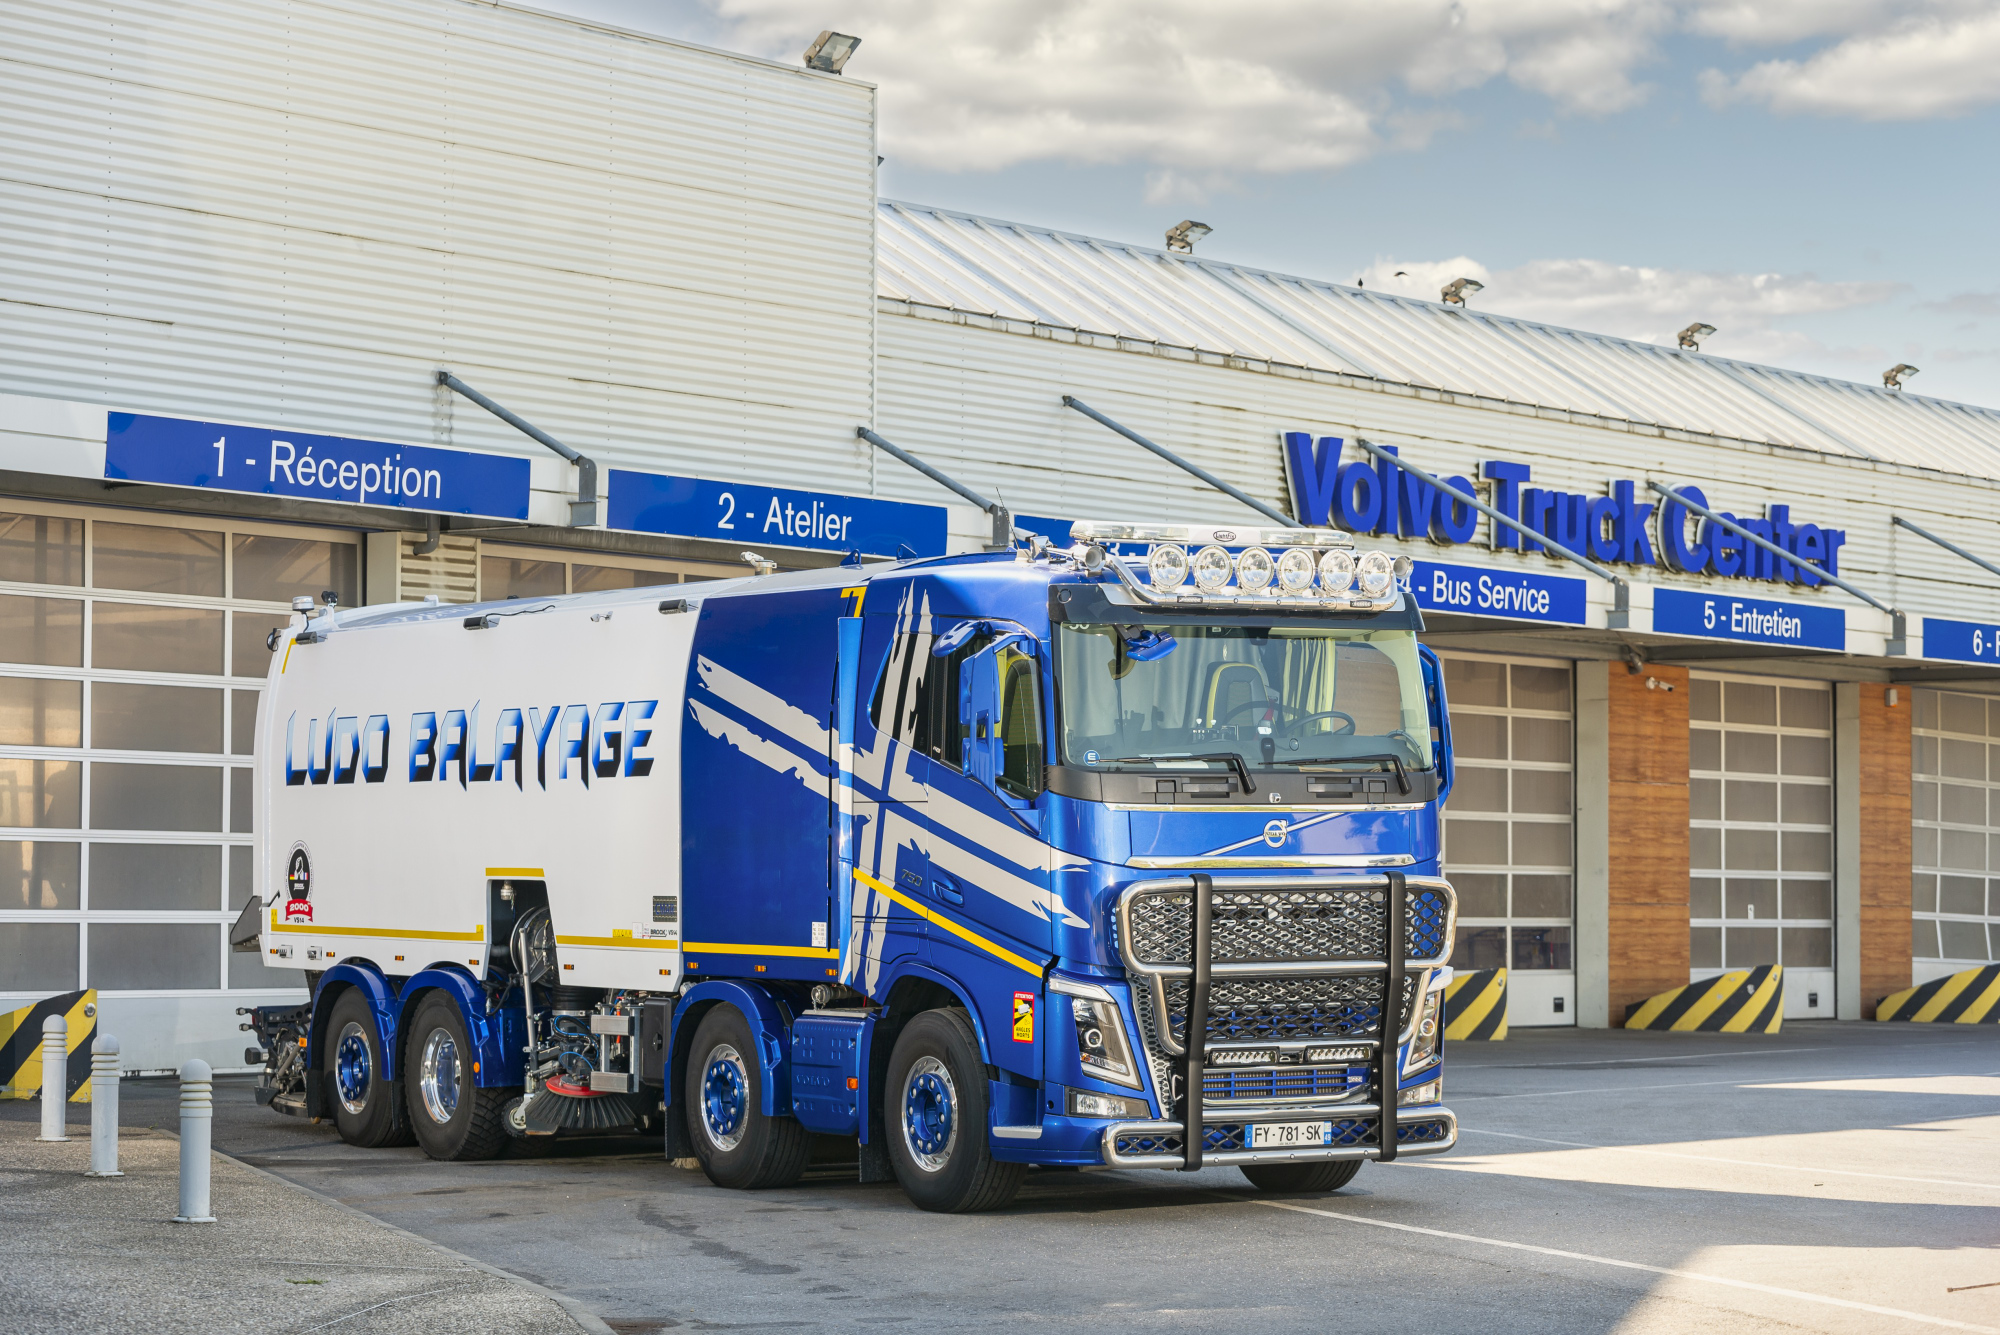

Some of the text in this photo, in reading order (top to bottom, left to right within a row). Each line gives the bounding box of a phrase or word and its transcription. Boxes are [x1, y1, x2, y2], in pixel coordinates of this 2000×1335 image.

[212, 437, 441, 503] 1 - Réception
[717, 492, 735, 530] 2
[762, 496, 852, 541] Atelier
[1284, 431, 1846, 587] Volvo Truck Center
[1432, 570, 1472, 606] Bus
[1477, 575, 1550, 614] Service
[1703, 601, 1716, 630] 5
[1731, 602, 1802, 639] Entretien
[1972, 629, 1983, 656] 6
[285, 699, 659, 793] LUDO BALAYAGE
[902, 868, 923, 887] 750
[289, 902, 309, 912] 2000
[1324, 1133, 1331, 1141] 49
